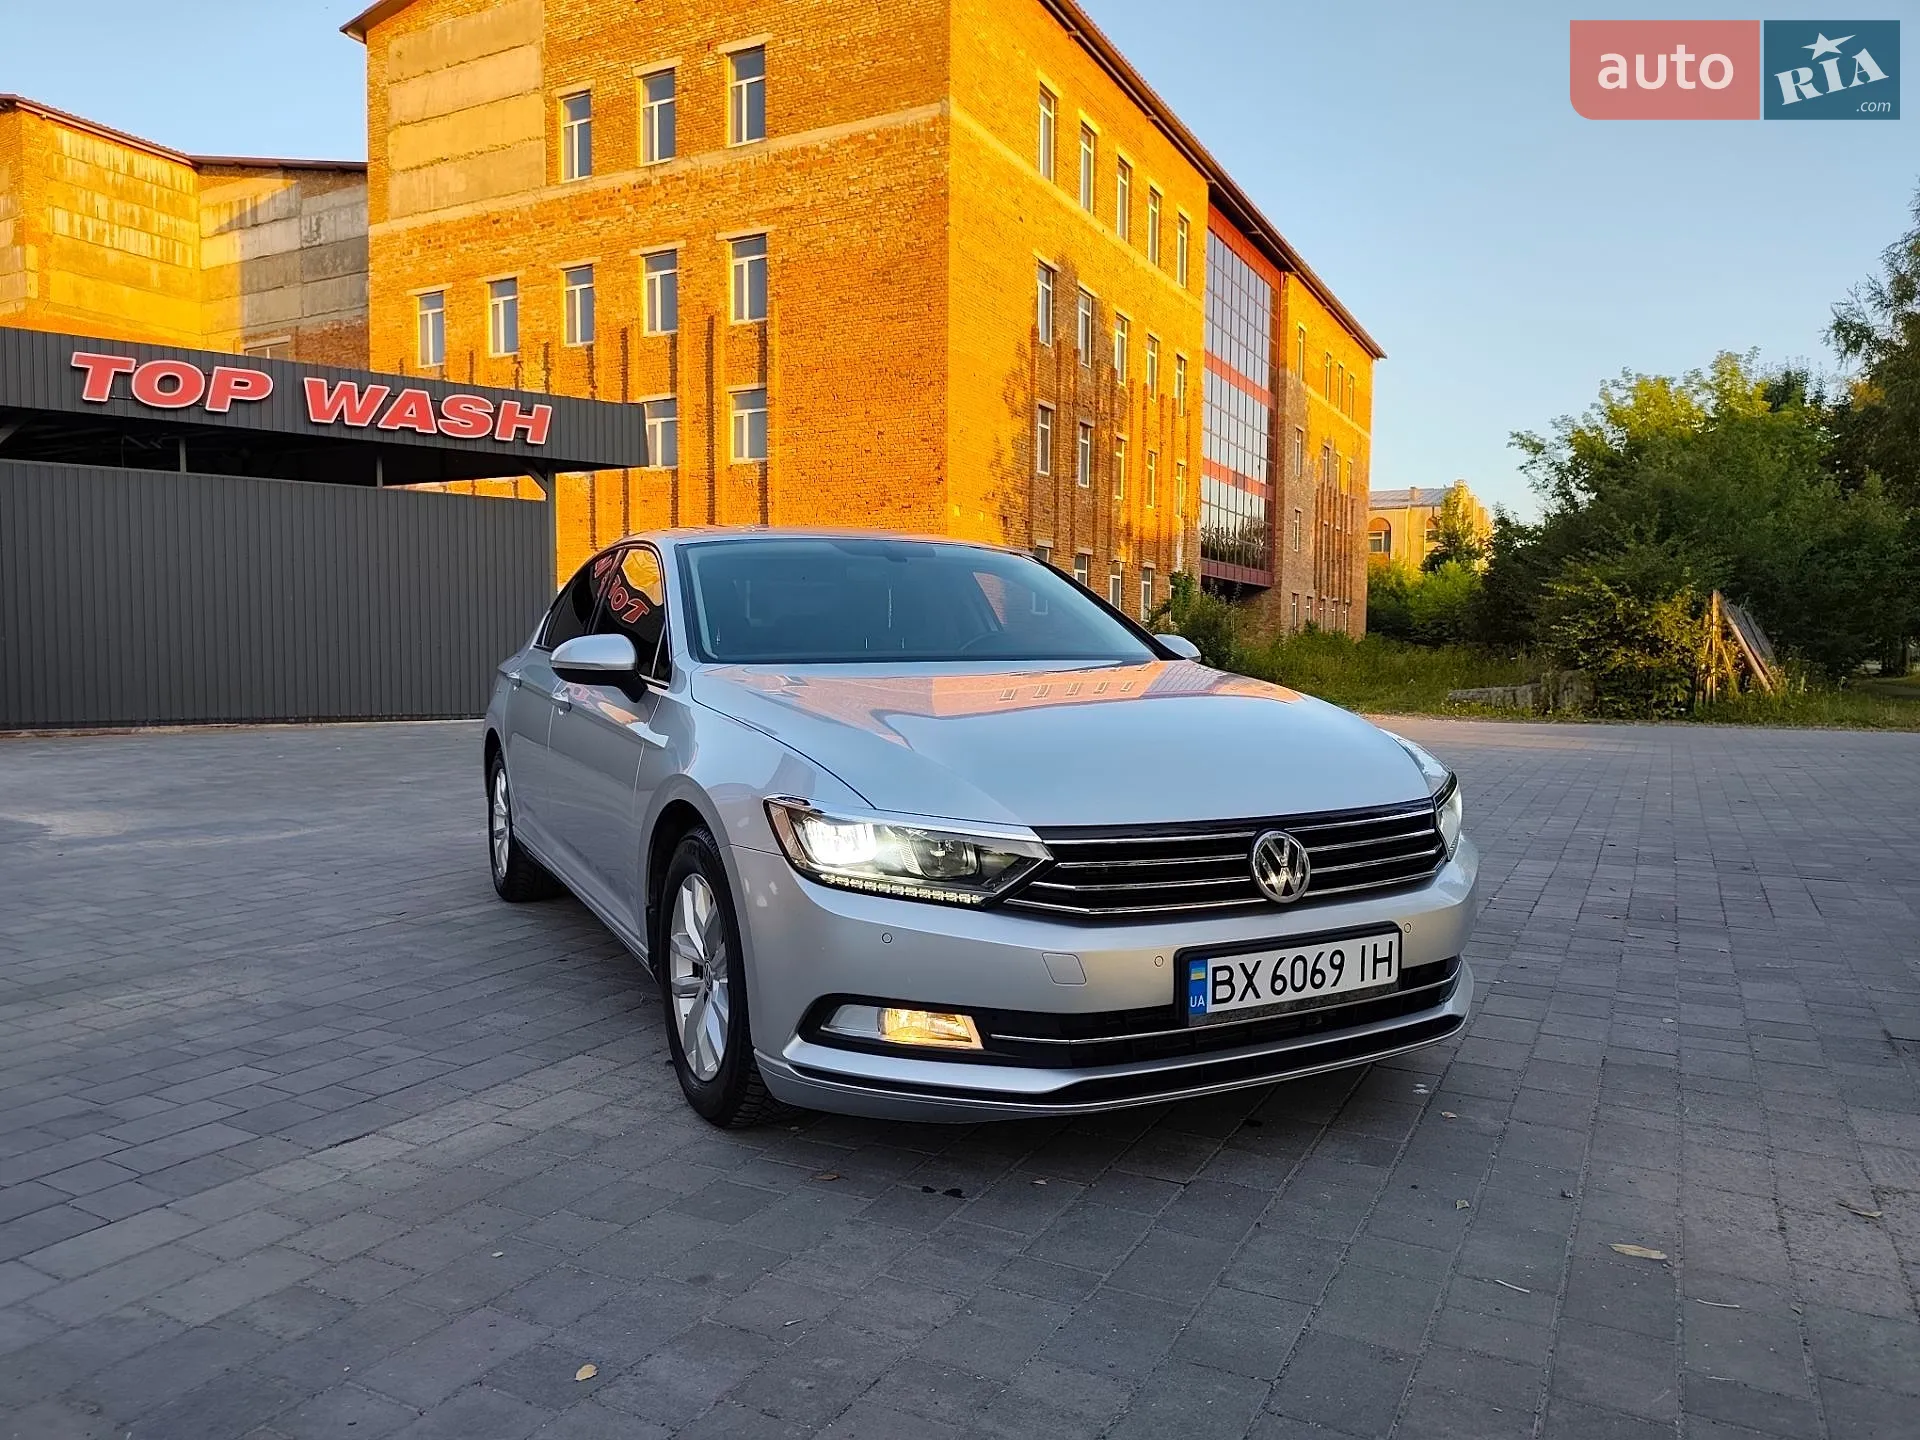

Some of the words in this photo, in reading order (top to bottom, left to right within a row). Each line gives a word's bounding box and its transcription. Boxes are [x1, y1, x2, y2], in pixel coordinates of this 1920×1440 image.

[71, 352, 273, 413] TOP
[303, 377, 552, 444] WASH
[1190, 995, 1205, 1008] UA
[1211, 960, 1261, 1005] BX
[1270, 950, 1345, 995] 6069
[1360, 941, 1393, 982] IH
